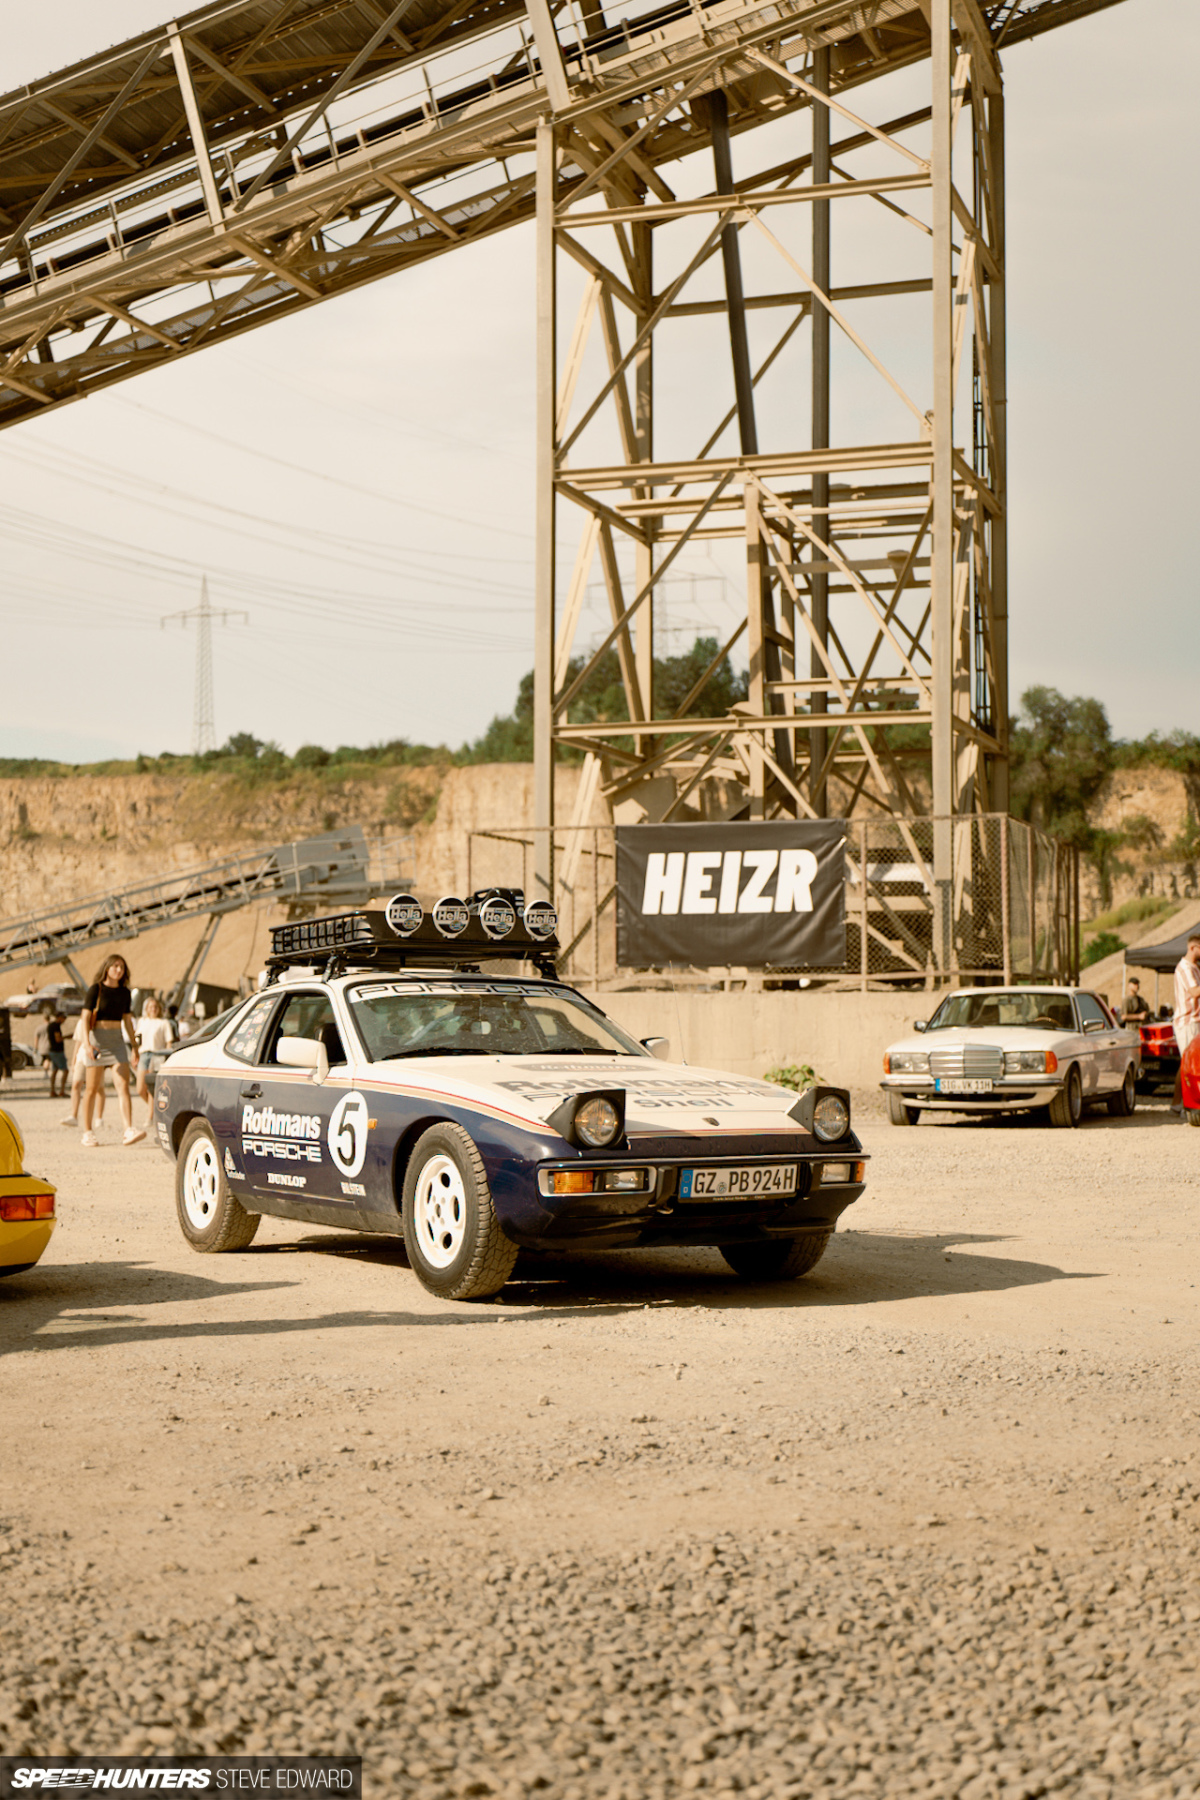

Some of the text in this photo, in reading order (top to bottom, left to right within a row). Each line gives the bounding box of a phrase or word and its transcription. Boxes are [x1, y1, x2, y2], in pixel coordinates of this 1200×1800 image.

[641, 849, 819, 915] HEIZR
[391, 908, 420, 919] Hella
[438, 911, 467, 921] Hella
[485, 912, 513, 923] Hella
[528, 914, 556, 924] Hella
[355, 983, 577, 1000] PORSCHE
[493, 1078, 772, 1092] Rothmans
[633, 1098, 734, 1108] Shell
[241, 1104, 322, 1140] Rothmans
[337, 1102, 360, 1167] 5
[241, 1140, 322, 1163] PORSCHE
[267, 1172, 307, 1188] DUNLOP
[694, 1172, 717, 1194] GZ
